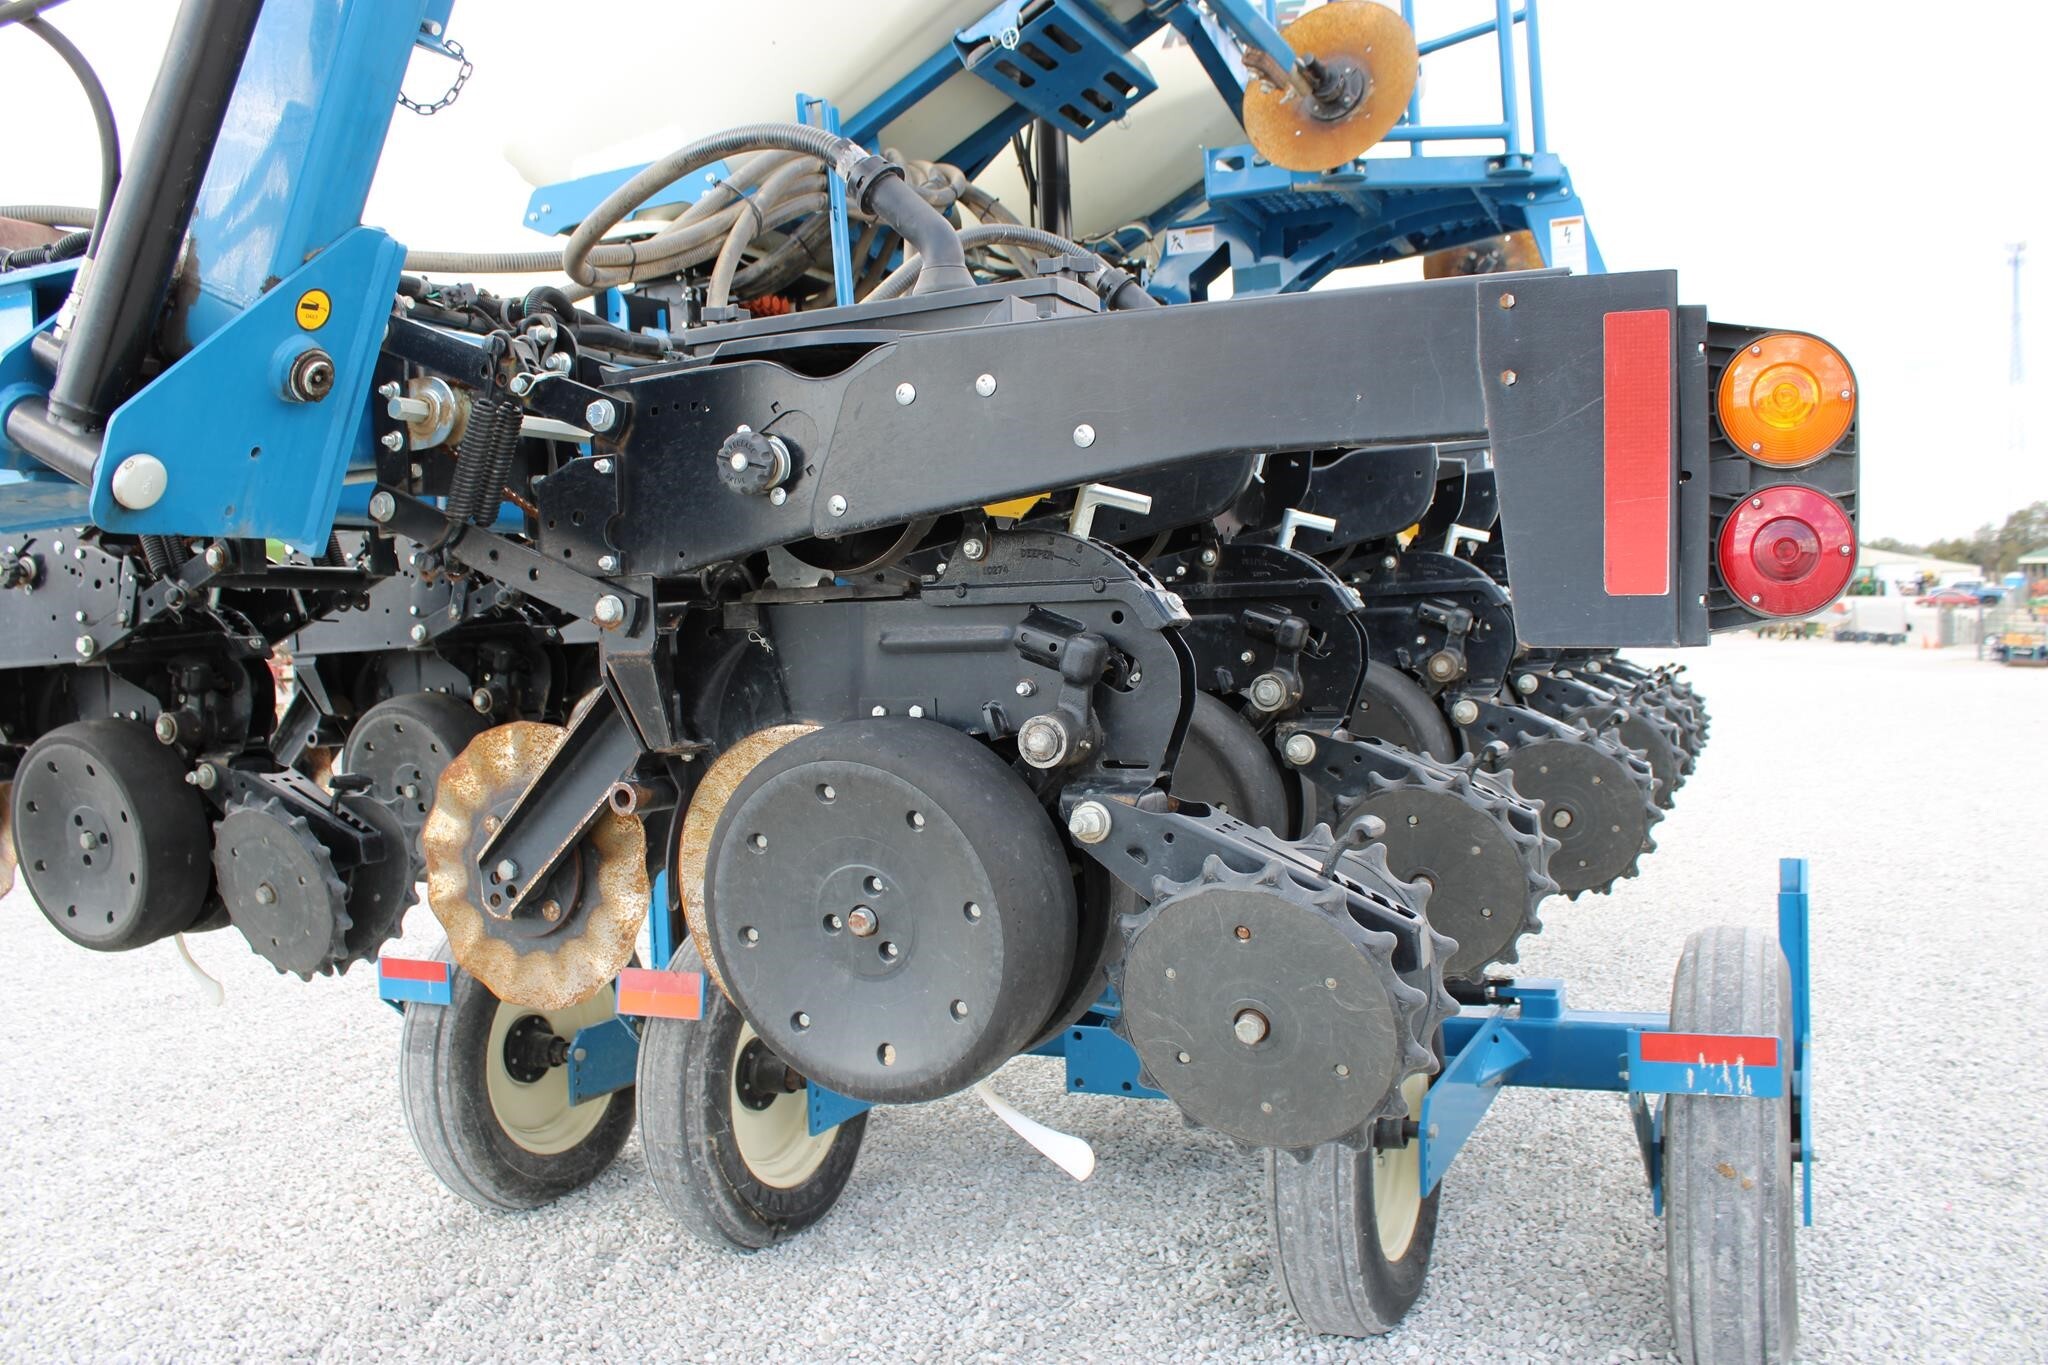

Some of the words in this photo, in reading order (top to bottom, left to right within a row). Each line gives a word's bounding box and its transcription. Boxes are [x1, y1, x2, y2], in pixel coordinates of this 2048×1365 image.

[728, 439, 758, 454] RELEASE
[725, 473, 745, 485] DRIVE
[1021, 549, 1055, 560] DEEPER
